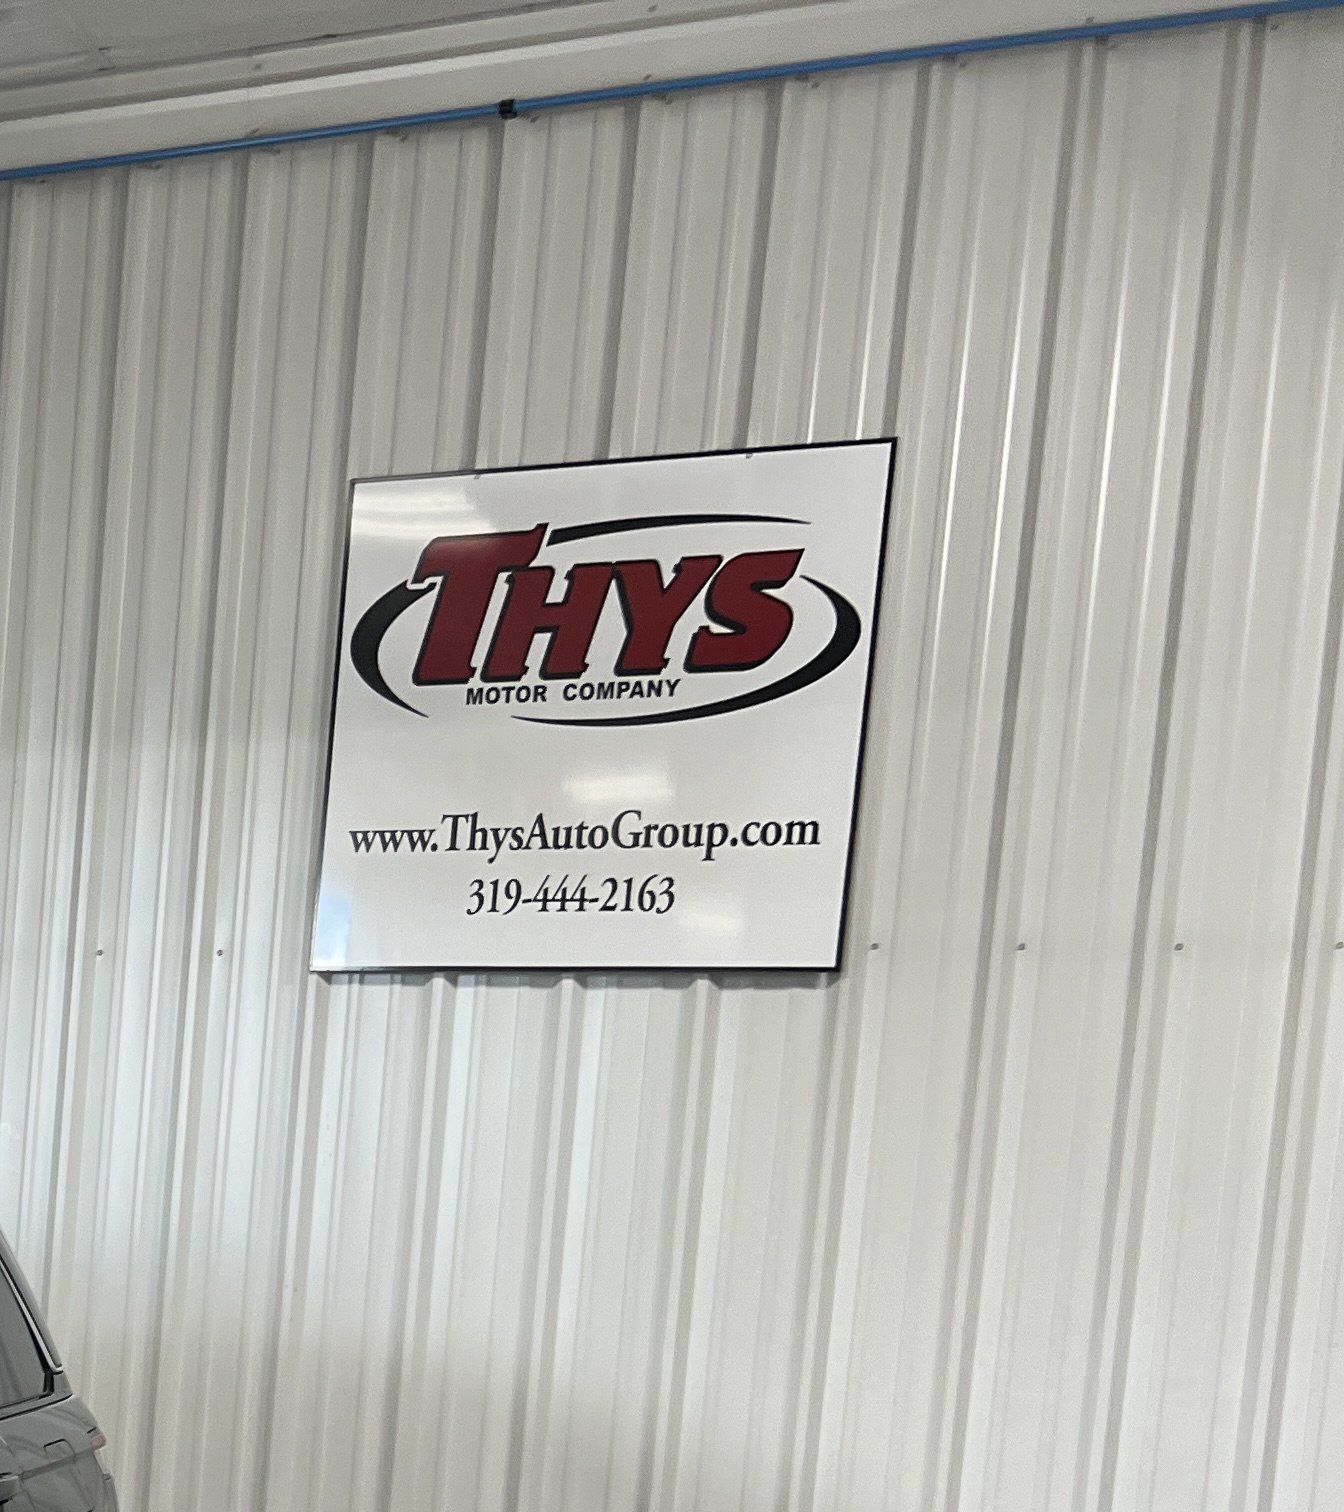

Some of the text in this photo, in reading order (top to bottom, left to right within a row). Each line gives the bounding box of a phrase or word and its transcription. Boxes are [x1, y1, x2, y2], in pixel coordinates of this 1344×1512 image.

[408, 522, 806, 687] THYS
[465, 678, 681, 706] MOTOR COMPANY
[348, 809, 821, 864] www.ThysAutoGroup.com
[465, 873, 676, 917] 319-444-2163
